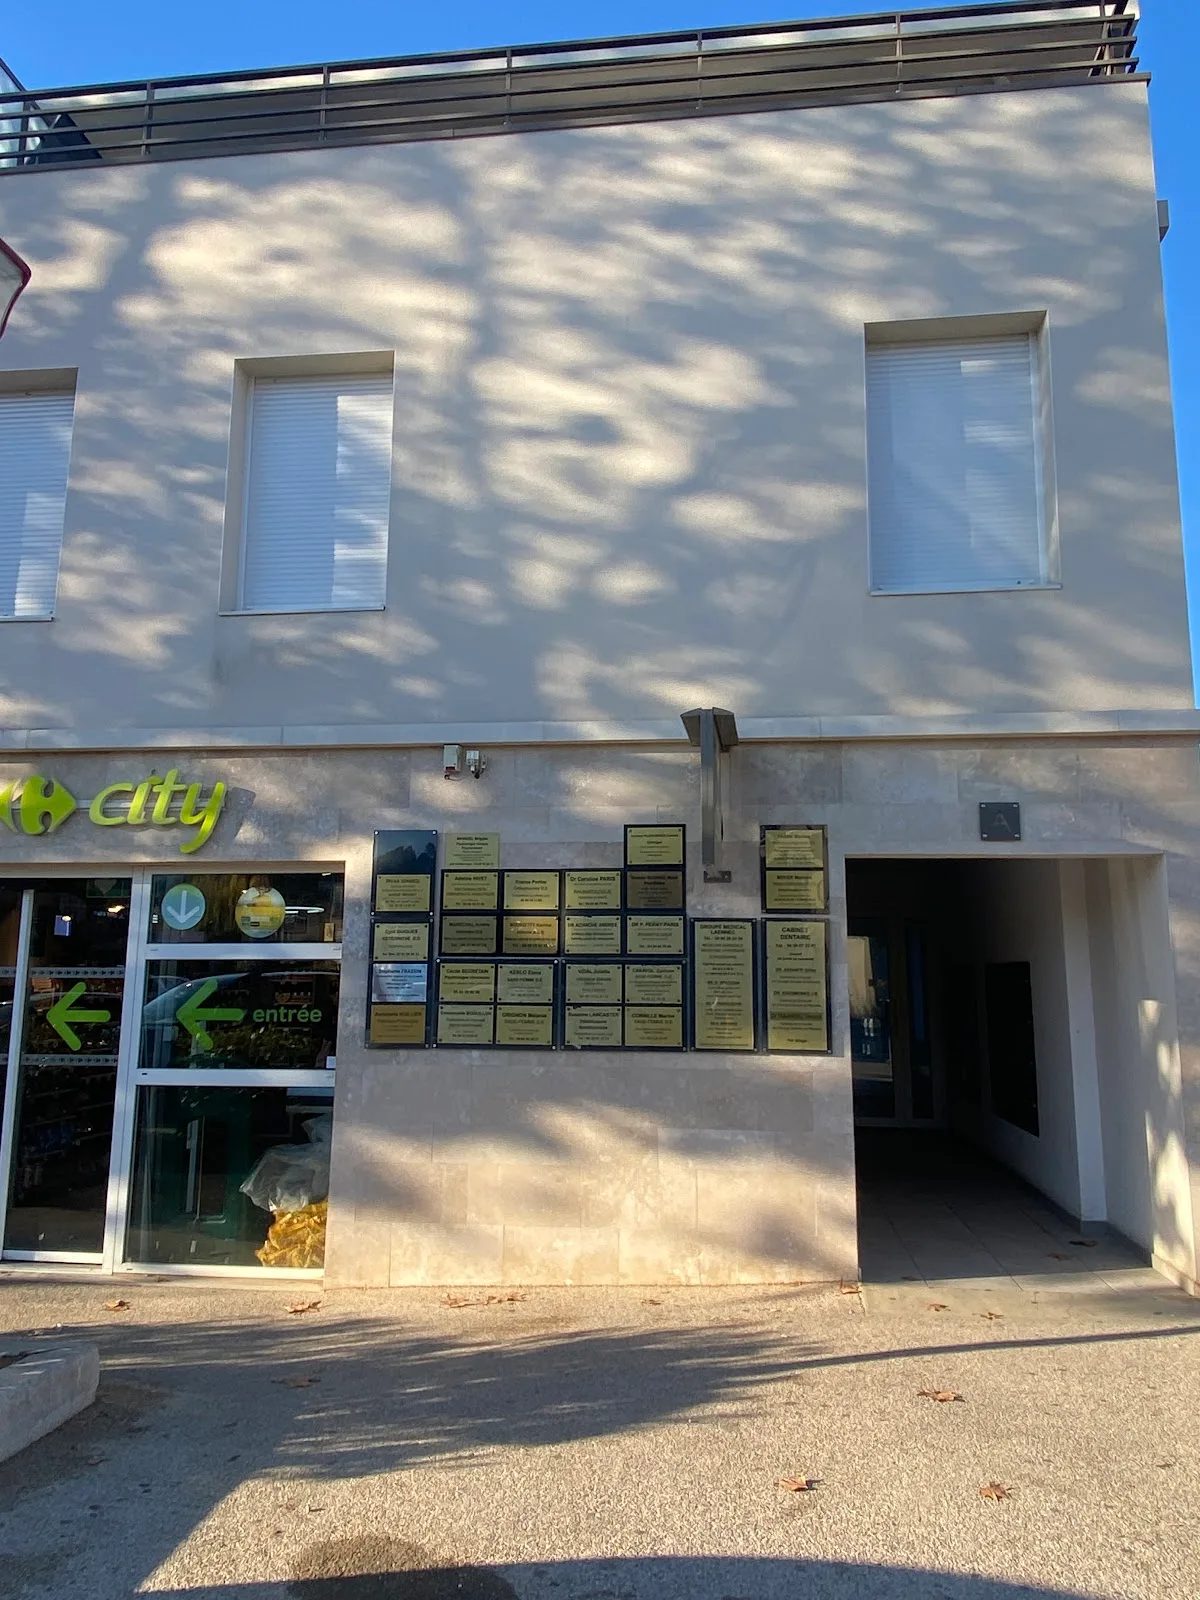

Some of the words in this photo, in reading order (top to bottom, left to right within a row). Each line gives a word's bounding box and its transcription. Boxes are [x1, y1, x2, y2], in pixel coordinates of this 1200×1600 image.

[89, 768, 226, 855] city
[989, 810, 1012, 833] A
[252, 1003, 322, 1023] entrée
